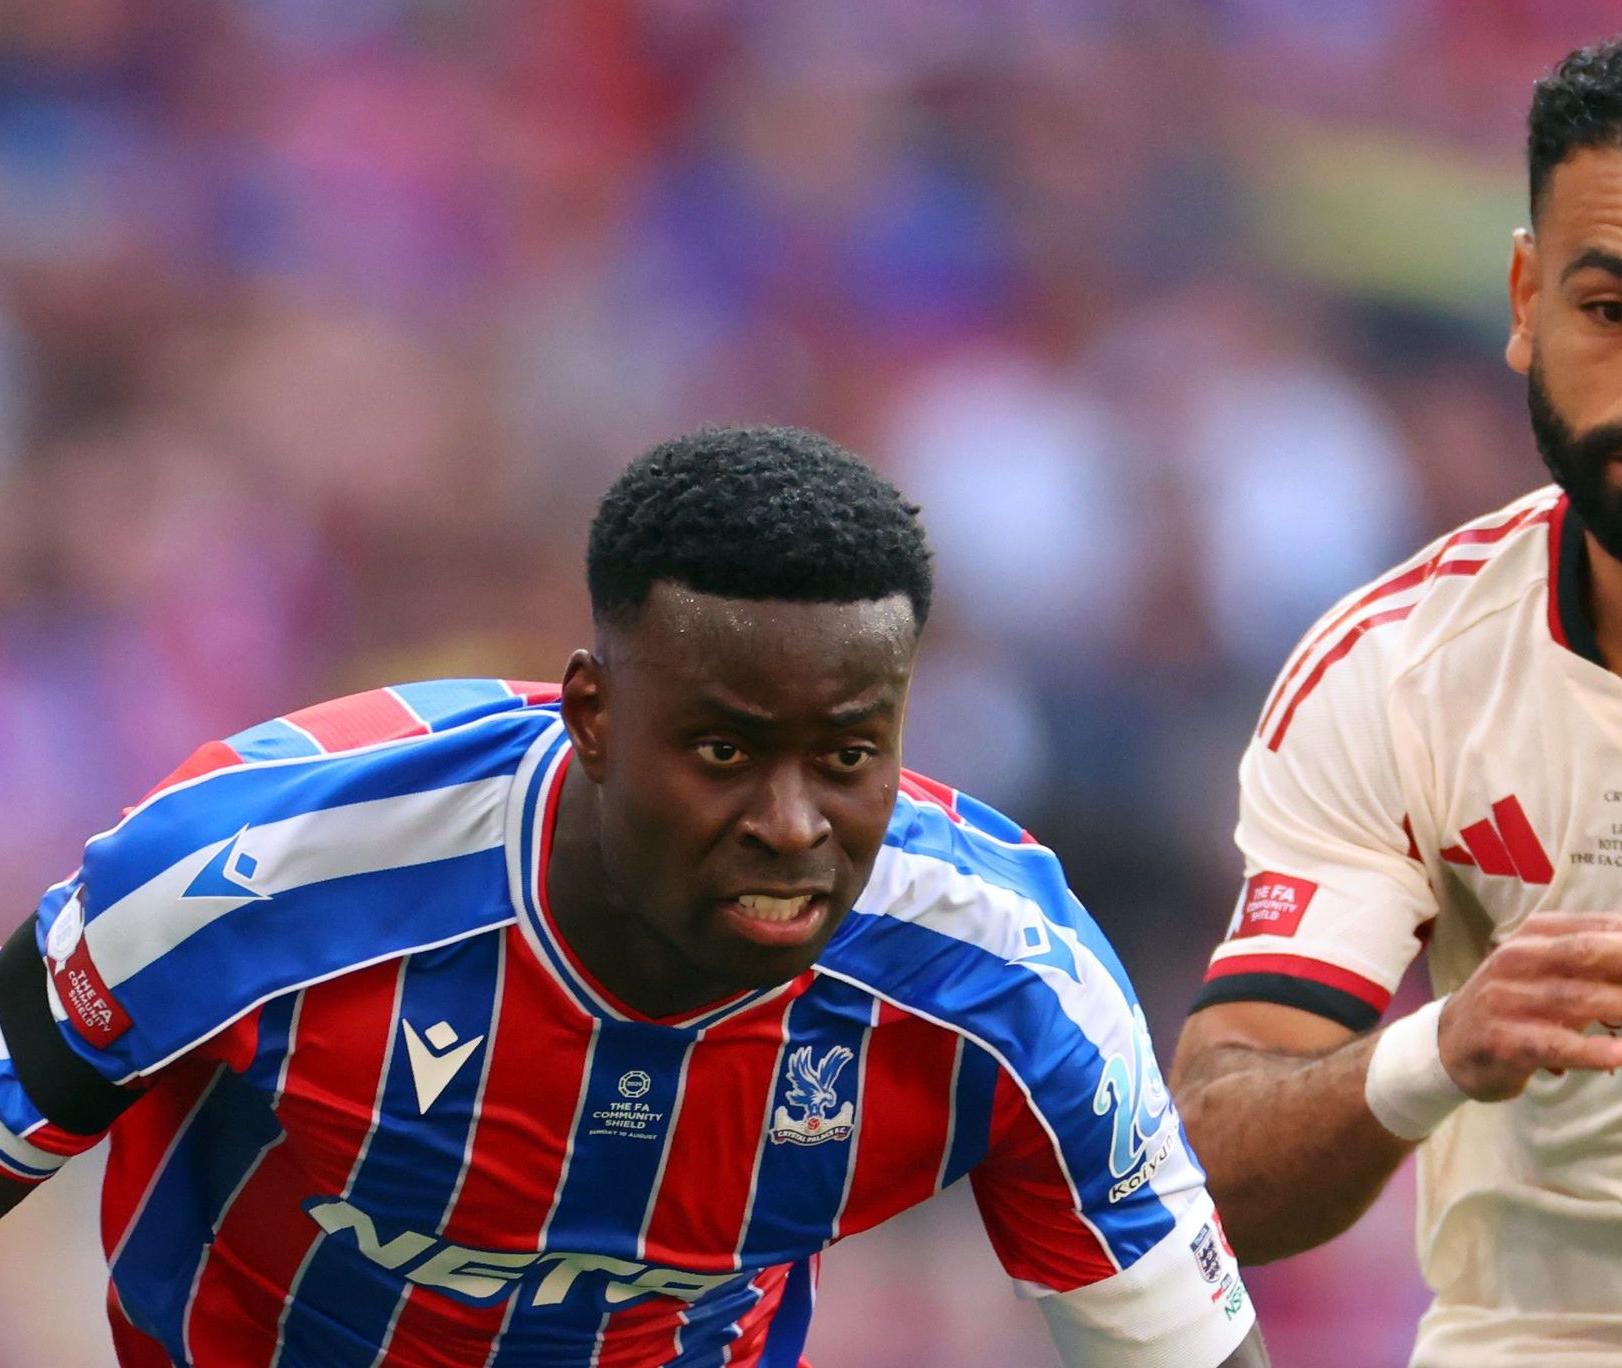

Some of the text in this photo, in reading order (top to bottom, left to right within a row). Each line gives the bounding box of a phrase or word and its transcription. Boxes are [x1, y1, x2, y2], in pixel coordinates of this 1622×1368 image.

[1569, 853, 1594, 865] THE
[1597, 855, 1612, 867] FA
[1270, 884, 1296, 904] FA
[68, 970, 112, 1032] COMMUNITY
[77, 969, 113, 1024] THE FA
[69, 989, 94, 1027] SHIELD
[609, 1102, 650, 1112] THE FA
[593, 1111, 663, 1121] COMMUNITY
[605, 1119, 646, 1129] SHIELD
[777, 1130, 807, 1142] CRYSTAL
[807, 1130, 834, 1142] PALACE
